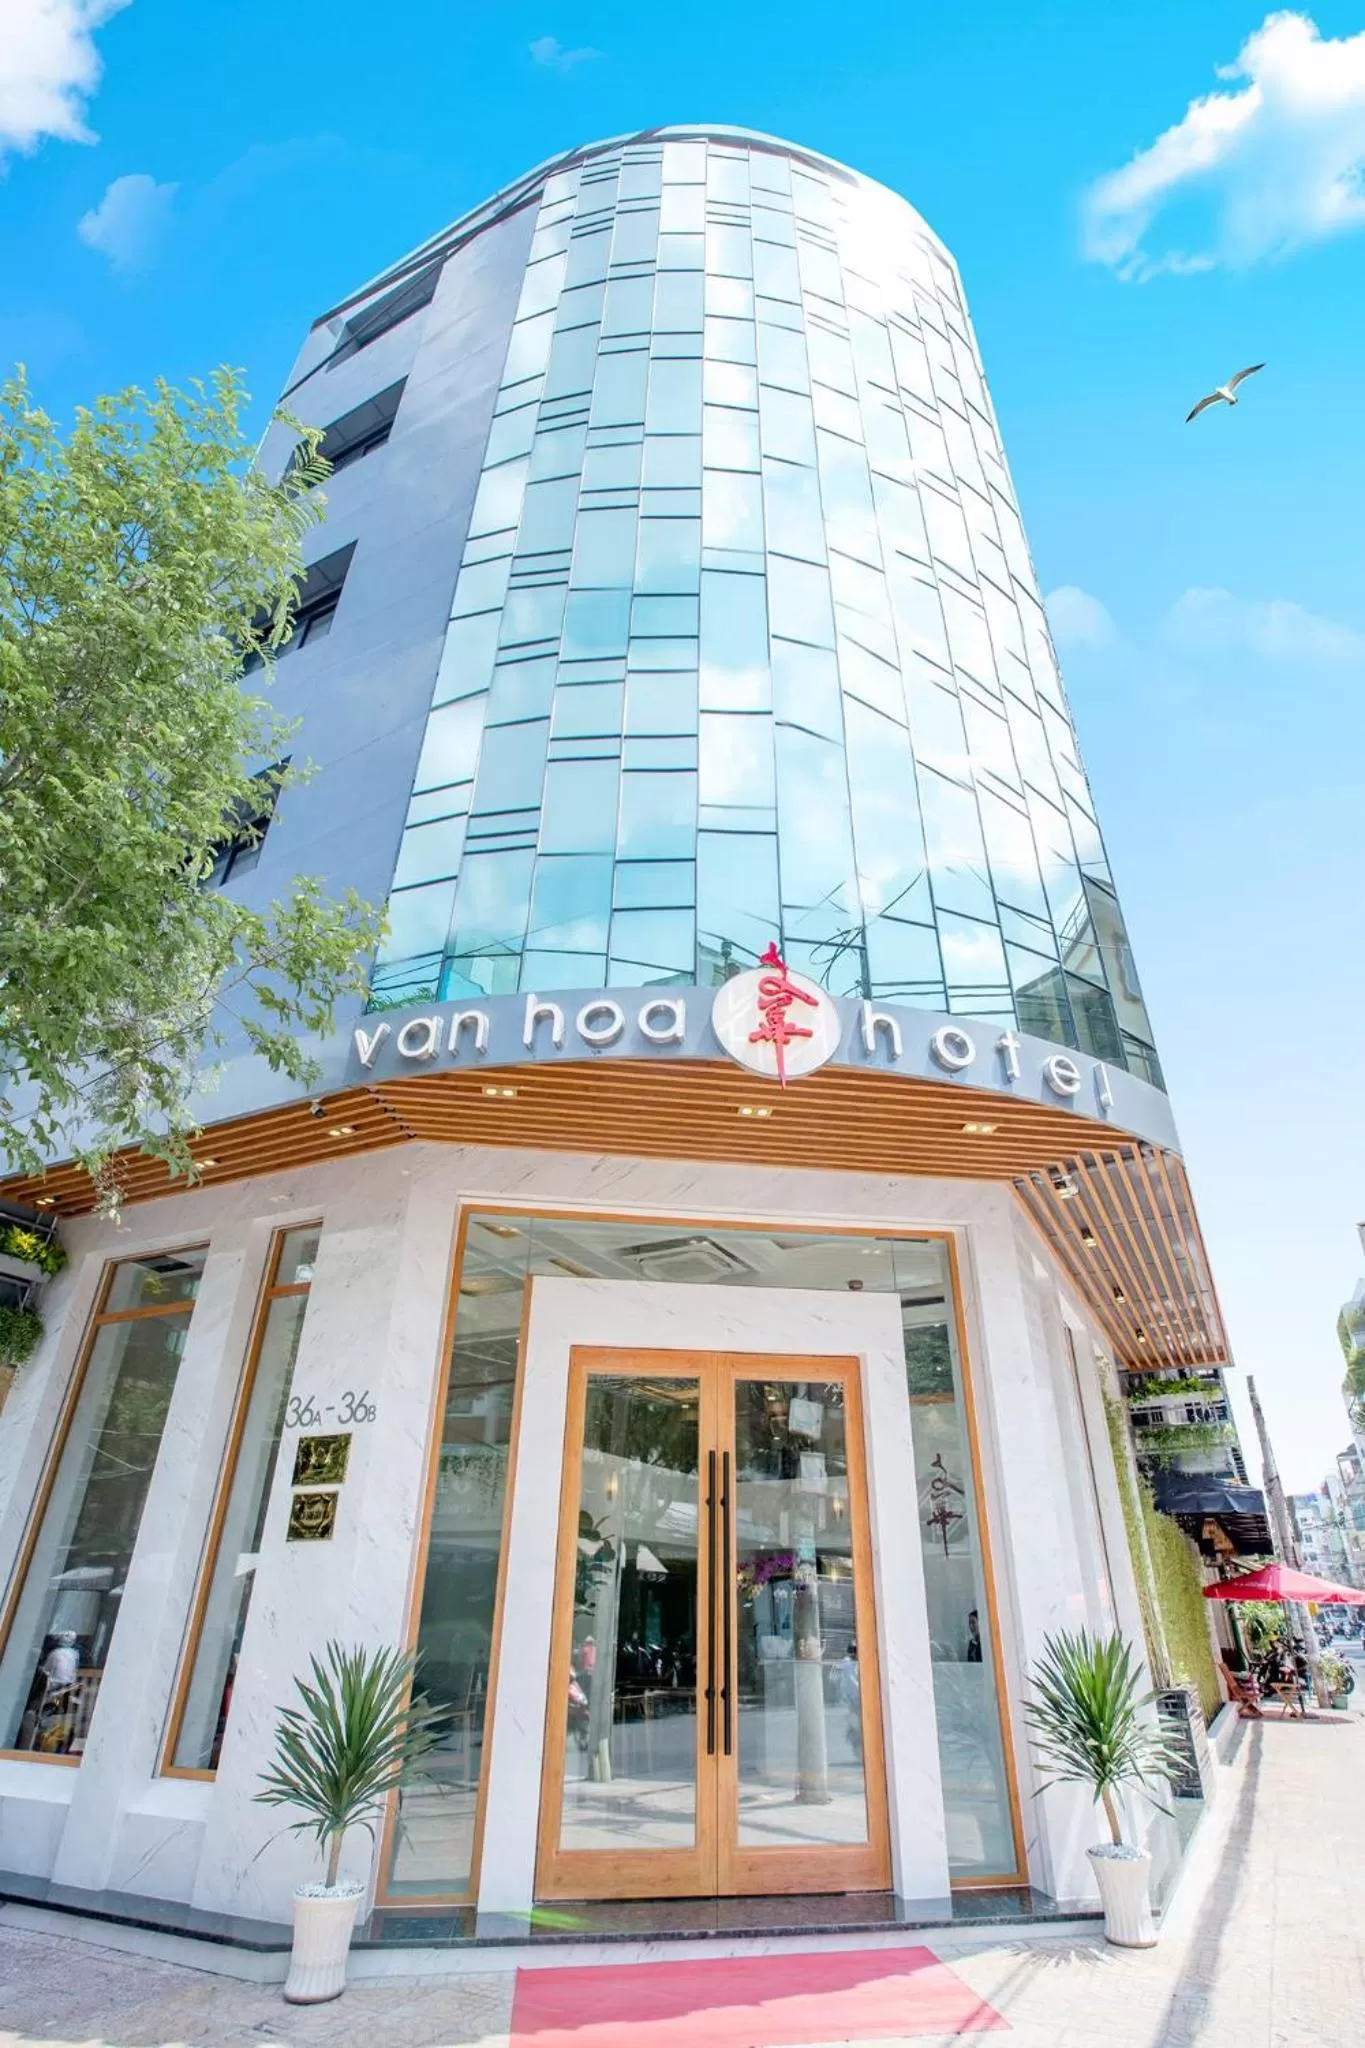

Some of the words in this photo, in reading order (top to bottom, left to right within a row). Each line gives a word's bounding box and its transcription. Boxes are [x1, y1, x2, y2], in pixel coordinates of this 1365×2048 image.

[354, 1010, 490, 1070] van
[523, 993, 686, 1051] hoa
[861, 999, 1114, 1112] hotel
